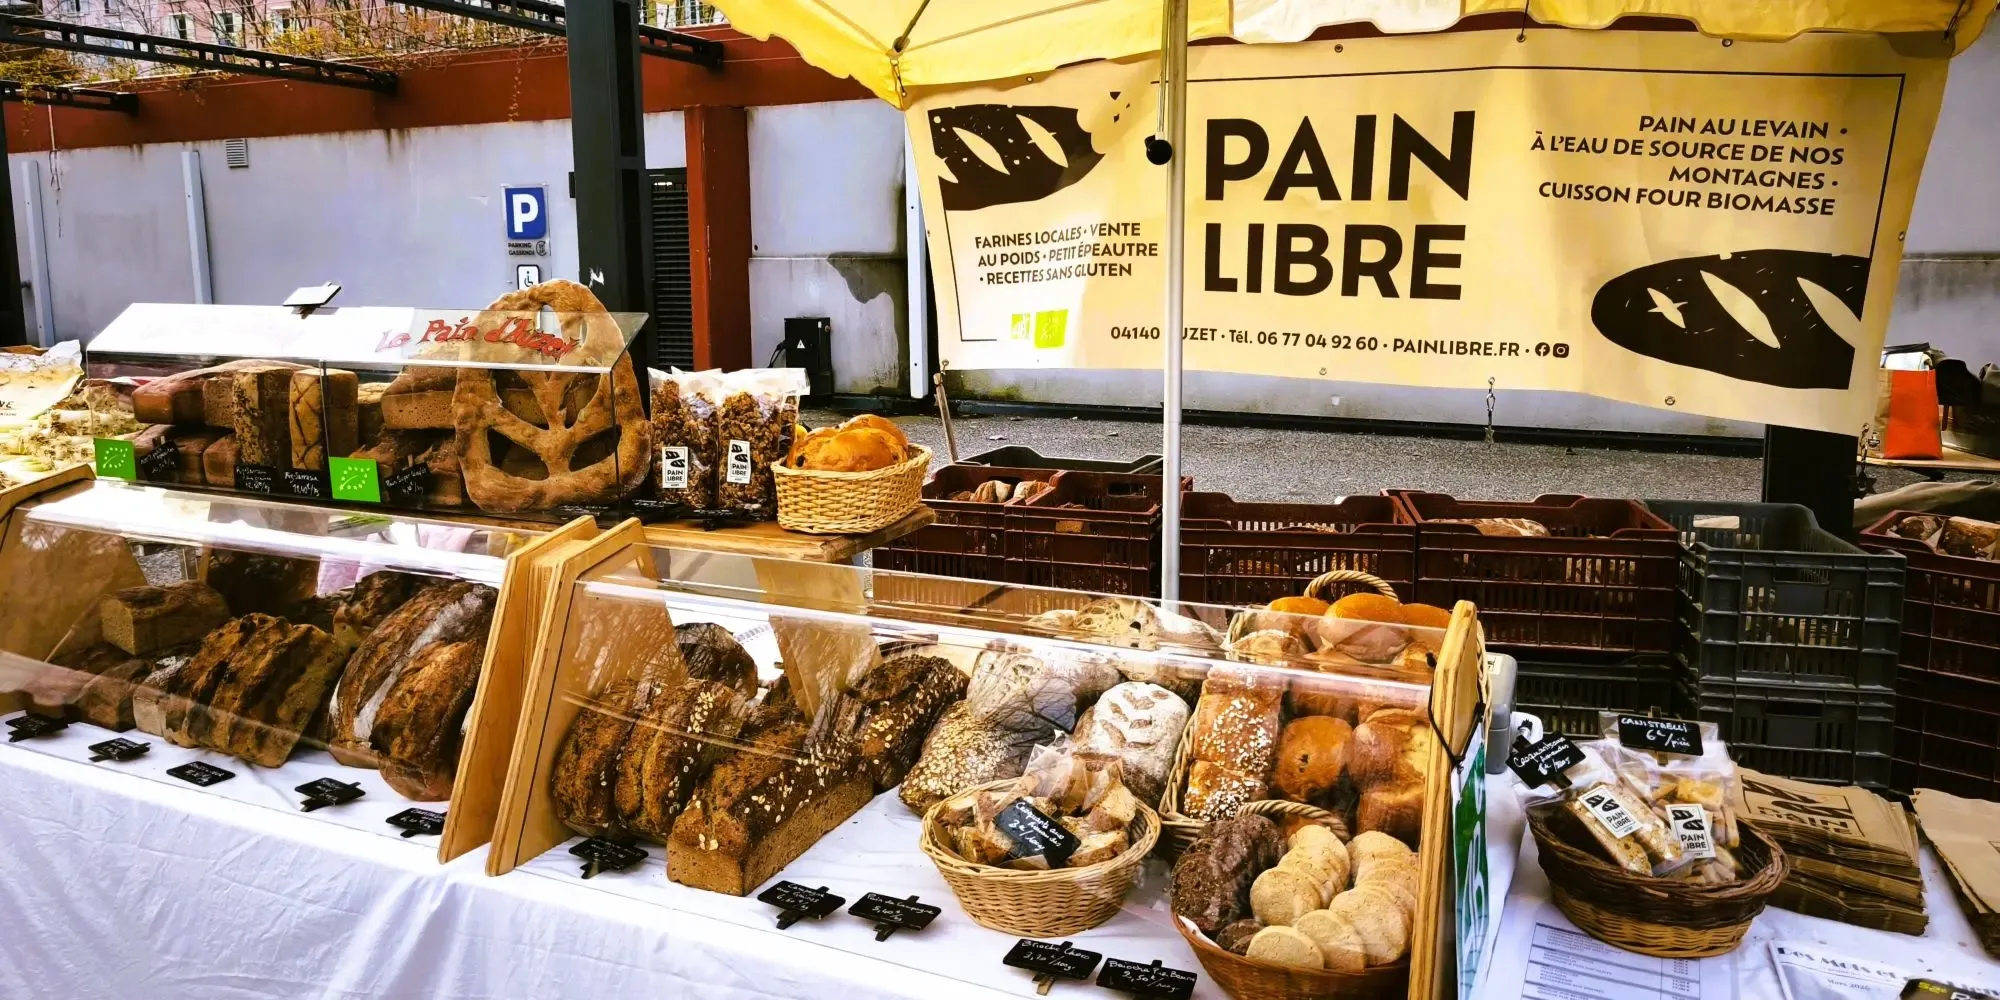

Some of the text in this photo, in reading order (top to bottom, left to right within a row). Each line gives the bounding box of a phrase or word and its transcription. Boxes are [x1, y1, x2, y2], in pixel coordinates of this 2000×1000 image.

[1639, 115, 1829, 138] PAIN AU LEVAIN
[1205, 110, 1475, 201] PAIN
[1530, 130, 1844, 166] À L'EAU DE SOURCE DE NOS
[1668, 165, 1825, 190] MONTAGNES
[1538, 181, 1836, 216] CUISSON FOUR BIOMASSE
[512, 193, 539, 233] P
[975, 222, 1141, 249] FARINES LOCALES VENTE
[978, 241, 1158, 268] AU POIDS PETIT ÉPEAUTRE
[1204, 222, 1466, 300] LIBRE
[987, 263, 1132, 285] RECETTES SANS GLUTEN
[417, 316, 479, 345] Pain
[1110, 326, 1161, 340] 04140
[1229, 329, 1253, 344] Tél.
[1257, 331, 1277, 346] 06
[1282, 333, 1300, 346] 77
[1305, 333, 1327, 348] 04
[1331, 334, 1351, 349] 92
[1355, 336, 1378, 350] 60
[1393, 338, 1520, 357] PAINLIBRE.FR
[1606, 810, 1626, 824] PAIN
[1612, 816, 1632, 830] LIBRE
[1681, 833, 1705, 842] PAIN
[1684, 841, 1707, 849] IBRE
[867, 893, 883, 903] Pain
[1021, 940, 1090, 960] Brioche Choco
[1108, 960, 1150, 973] Brioche
